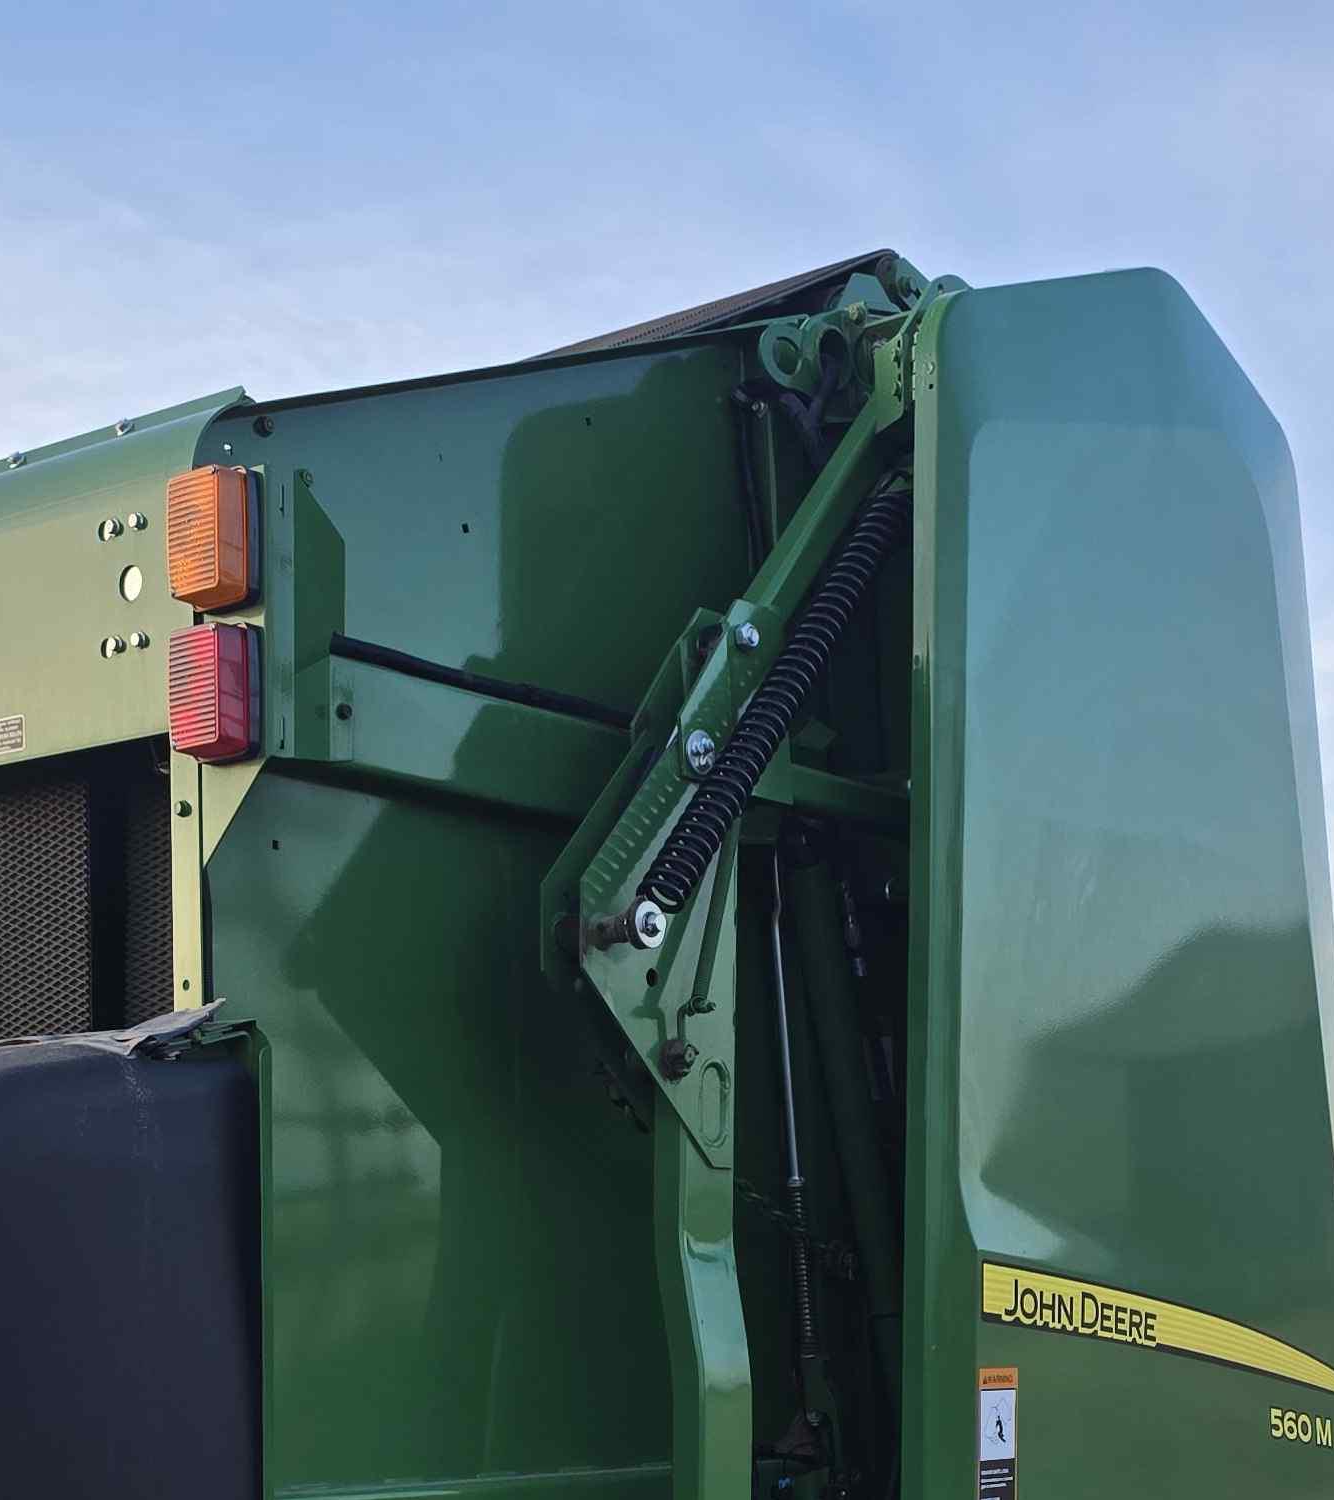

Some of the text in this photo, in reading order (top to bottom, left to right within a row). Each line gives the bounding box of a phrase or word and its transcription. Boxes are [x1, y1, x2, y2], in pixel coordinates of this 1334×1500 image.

[1004, 1278, 1157, 1342] JOHN DEERE
[1269, 1406, 1333, 1448] 560 M
